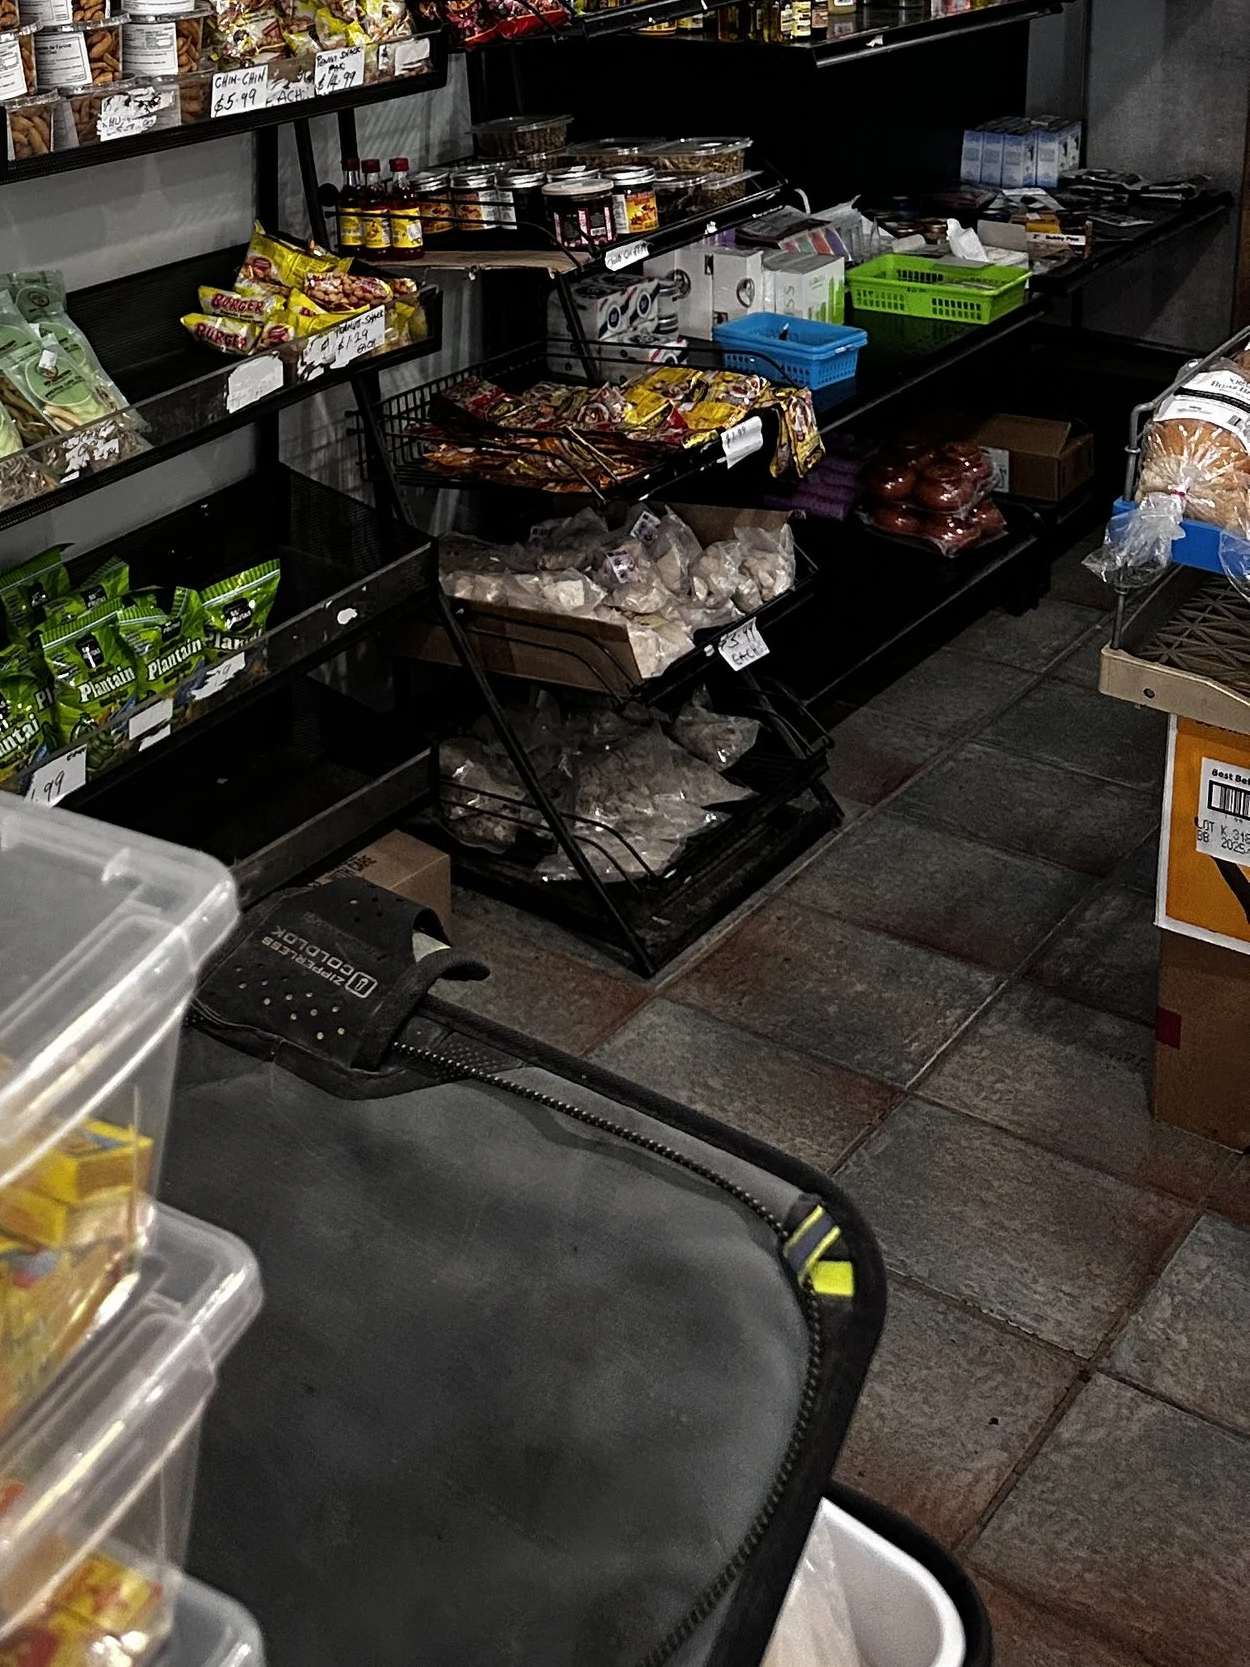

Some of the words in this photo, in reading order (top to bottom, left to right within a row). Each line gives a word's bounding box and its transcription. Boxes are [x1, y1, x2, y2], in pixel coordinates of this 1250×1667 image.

[215, 69, 265, 89] CHIN-CHIN
[214, 89, 257, 118] $5.99
[211, 293, 264, 314] BURGER
[146, 636, 203, 682] Plantain
[77, 665, 137, 704] Plantain
[1211, 768, 1233, 781] Best
[1221, 825, 1228, 836] K
[261, 936, 346, 987] ZIPPERLESS
[271, 925, 354, 977] COLDLOK
